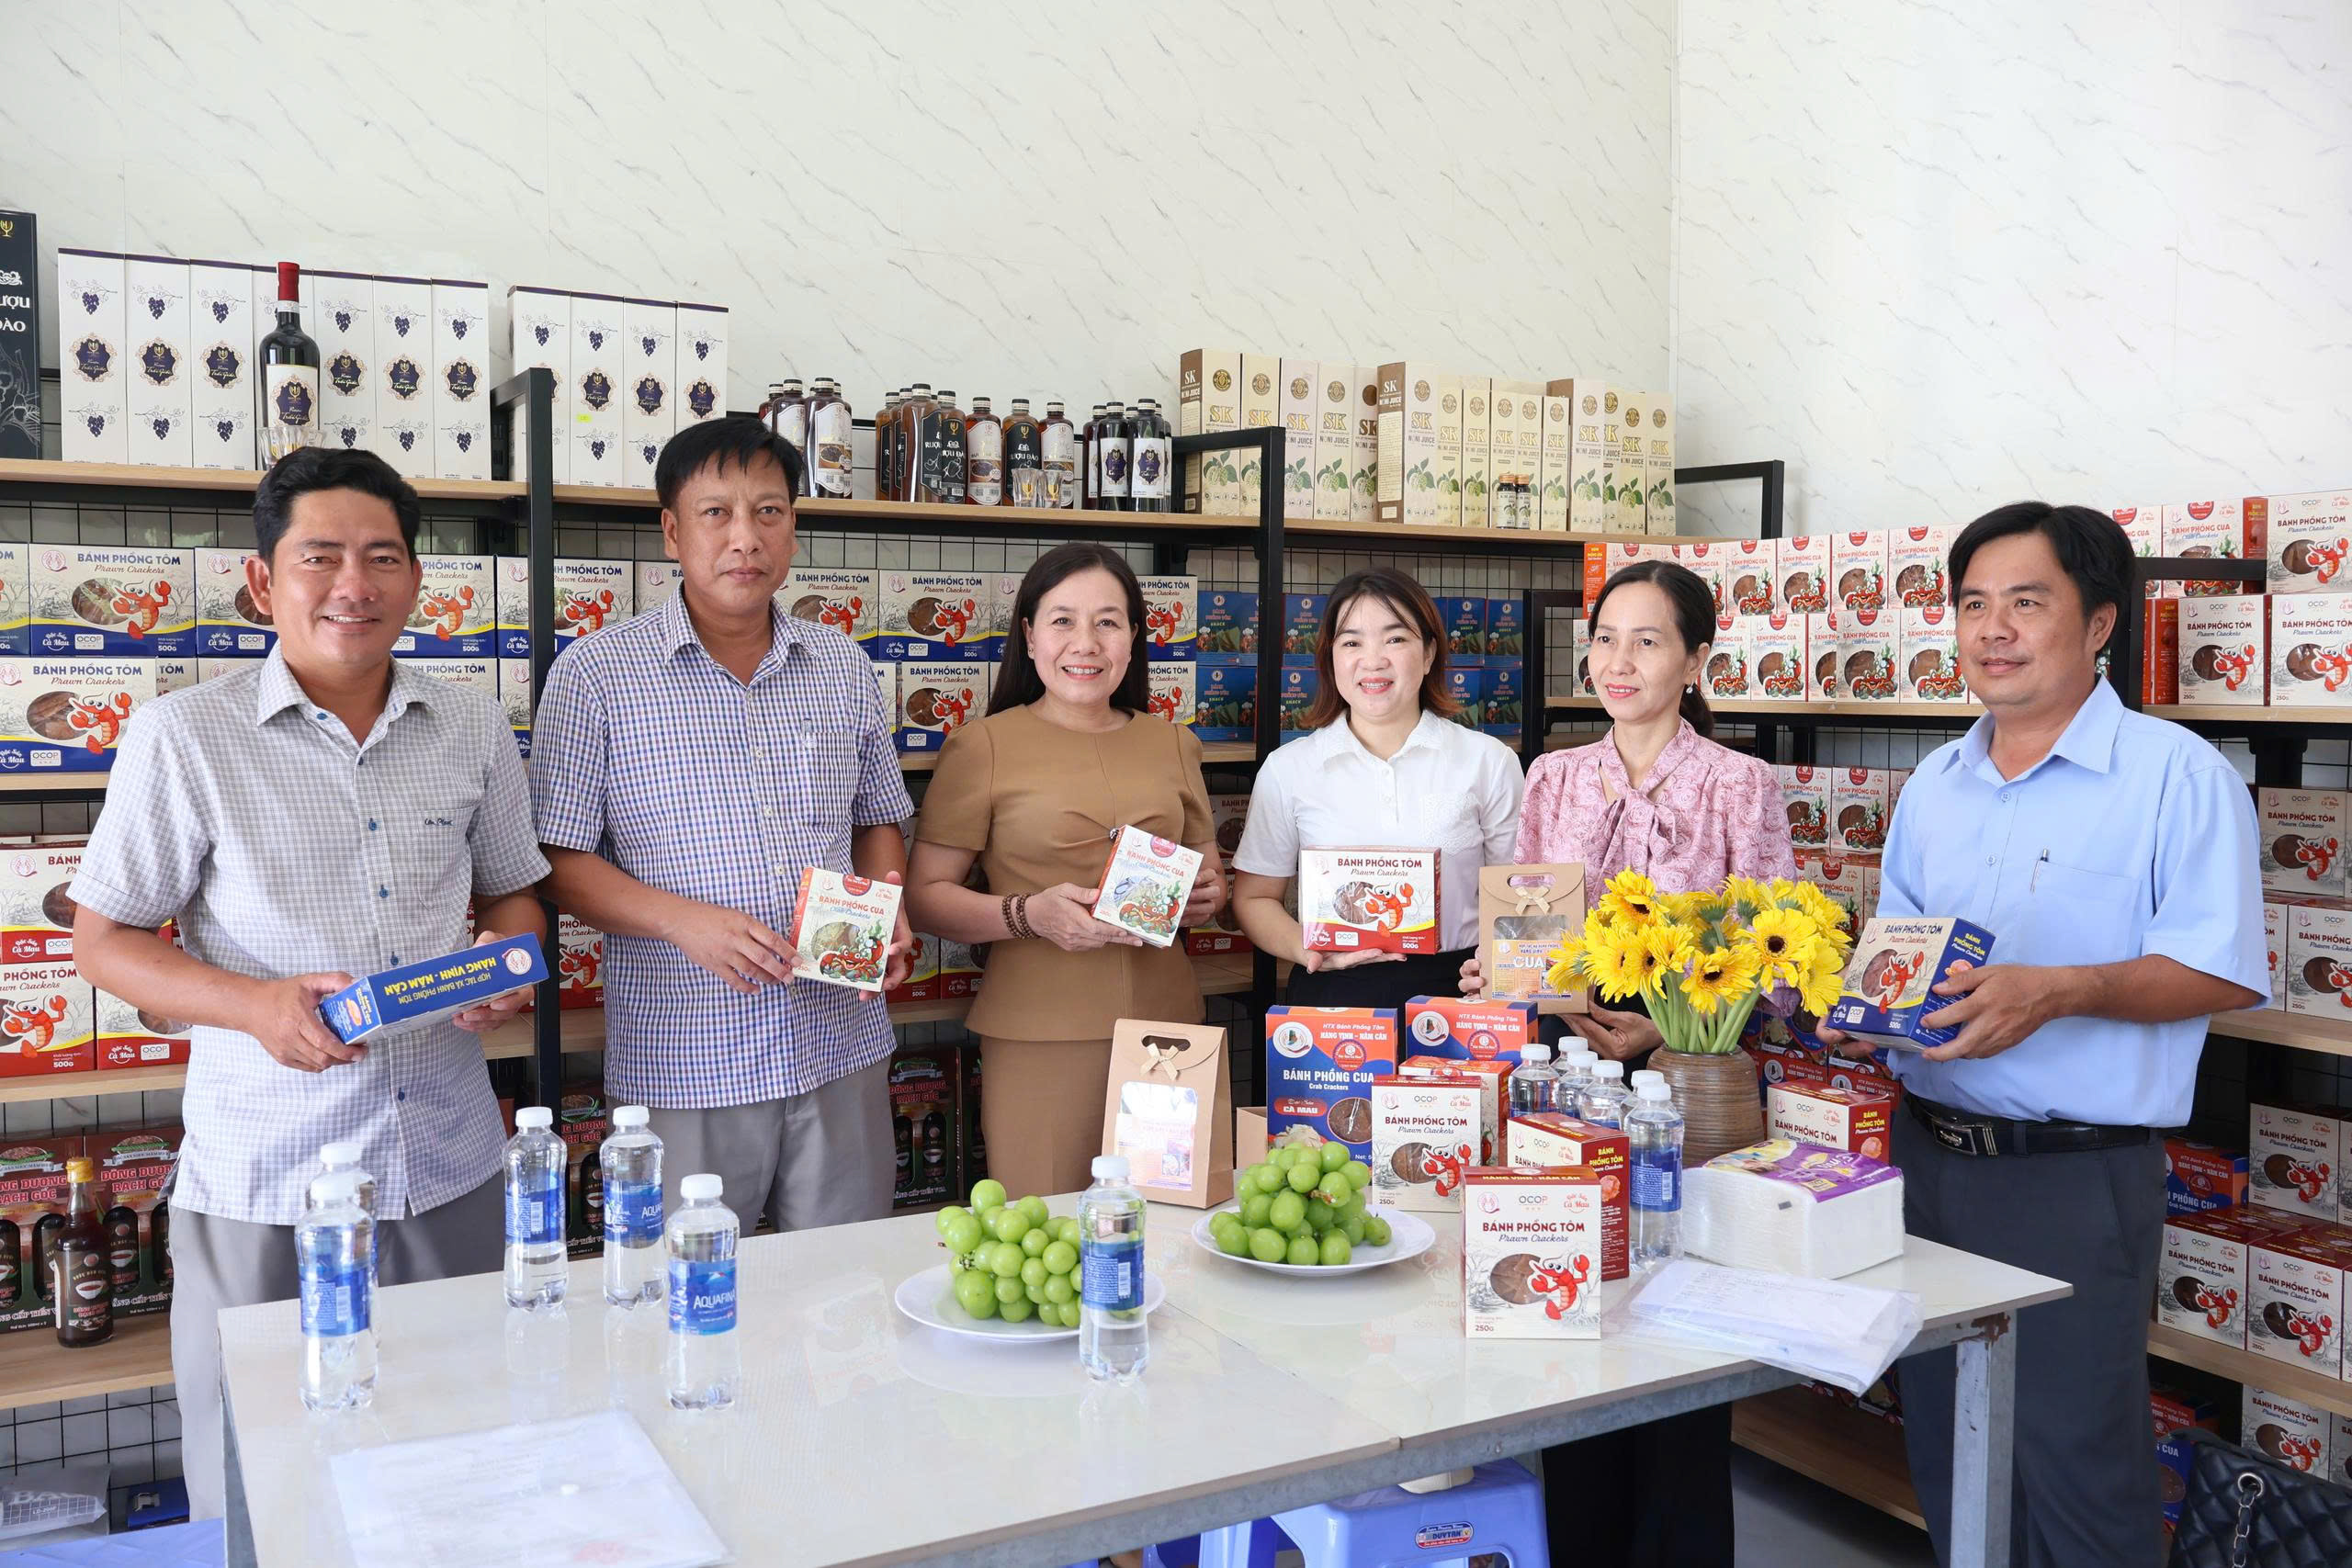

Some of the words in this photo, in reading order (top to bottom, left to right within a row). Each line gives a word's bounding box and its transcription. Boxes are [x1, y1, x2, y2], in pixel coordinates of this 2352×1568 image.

[1185, 370, 1195, 384] SK
[1385, 380, 1396, 393] SK
[1210, 405, 1234, 423] SK
[1250, 410, 1272, 426] SK
[1286, 413, 1310, 431] SK
[1324, 412, 1346, 430] SK
[1411, 412, 1432, 430] SK
[1441, 426, 1458, 441] SK
[1468, 428, 1486, 442] SK
[1496, 430, 1513, 444] SK
[1496, 430, 1513, 444] SK
[1579, 425, 1599, 442] SK
[1521, 433, 1538, 446] SK
[1548, 434, 1566, 448] SK
[1623, 436, 1642, 452] SK
[1652, 440, 1669, 456] SK
[2278, 517, 2298, 527] BÁNH
[2329, 515, 2346, 524] TÔM
[156, 554, 180, 566] TÔM
[95, 565, 124, 573] Prawn
[127, 566, 164, 574] Crackers
[461, 561, 481, 570] TÔM
[602, 566, 622, 575] TÔM
[435, 571, 468, 580] Crackers
[578, 575, 608, 583] Crackers
[796, 572, 819, 582] BÁNH
[853, 574, 869, 583] TÔM
[912, 575, 933, 585] BÁNH
[966, 577, 982, 586] TÔM
[1174, 581, 1190, 589] TÔM
[808, 583, 829, 592] Prawn
[831, 583, 858, 592] Crackers
[946, 586, 971, 594] Crackers
[2282, 620, 2303, 628] BÁNH
[33, 665, 66, 675] BÁNH
[114, 665, 141, 676] TÔM
[465, 663, 485, 672] TÔM
[910, 666, 930, 675] BÁNH
[963, 667, 980, 676] TÔM
[1171, 666, 1188, 675] TÔM
[51, 677, 82, 685] Prawn
[85, 677, 125, 685] Crackers
[2267, 811, 2288, 820] BÁNH
[2319, 814, 2335, 822] TÔM
[48, 854, 81, 865] BÁNH
[1338, 857, 1363, 867] BÁNH
[1399, 857, 1422, 868] TÔM
[1171, 866, 1184, 877] CUA
[1351, 868, 1374, 877] Prawn
[1377, 869, 1408, 877] Crackers
[870, 906, 884, 915] CUA
[1884, 925, 1902, 933] BÁNH
[1926, 925, 1943, 934] TÔM
[1905, 936, 1928, 944] Crackers
[2299, 931, 2320, 942] BÁNH
[471, 956, 496, 971] HÀNG
[51, 968, 77, 978] TÔM
[440, 964, 465, 980] VỊNH
[20, 981, 60, 990] Crackers
[409, 975, 434, 988] NĂM
[1283, 1069, 1310, 1080] BÁNH
[1353, 1071, 1374, 1082] CUA
[1283, 1104, 1295, 1113] CÀ
[1297, 1106, 1317, 1114] MAU
[1796, 1103, 1815, 1112] OCOP
[1385, 1115, 1410, 1125] BÁNH
[1448, 1115, 1467, 1126] TÔM
[1398, 1126, 1421, 1134] Prawn
[1423, 1126, 1454, 1134] Crackers
[1775, 1120, 1792, 1131] BÁNH
[1825, 1132, 1838, 1144] TÔM
[2259, 1129, 2279, 1140] BÁNH
[1533, 1138, 1550, 1148] OCOP
[2310, 1140, 2327, 1148] TÔM
[1598, 1146, 1614, 1156] BÁNH
[1611, 1155, 1623, 1164] TÔM
[1519, 1195, 1548, 1204] OCOP
[1483, 1220, 1514, 1232] BÁNH
[1560, 1221, 1585, 1232] TÔM
[1498, 1234, 1529, 1243] Prawn
[1531, 1234, 1568, 1243] Crackers
[2168, 1250, 2188, 1262] BÁNH
[2218, 1264, 2235, 1275] TÔM
[2258, 1274, 2280, 1286] BÁNH
[2311, 1290, 2329, 1301] TÔM
[2162, 1444, 2178, 1457] CUA
